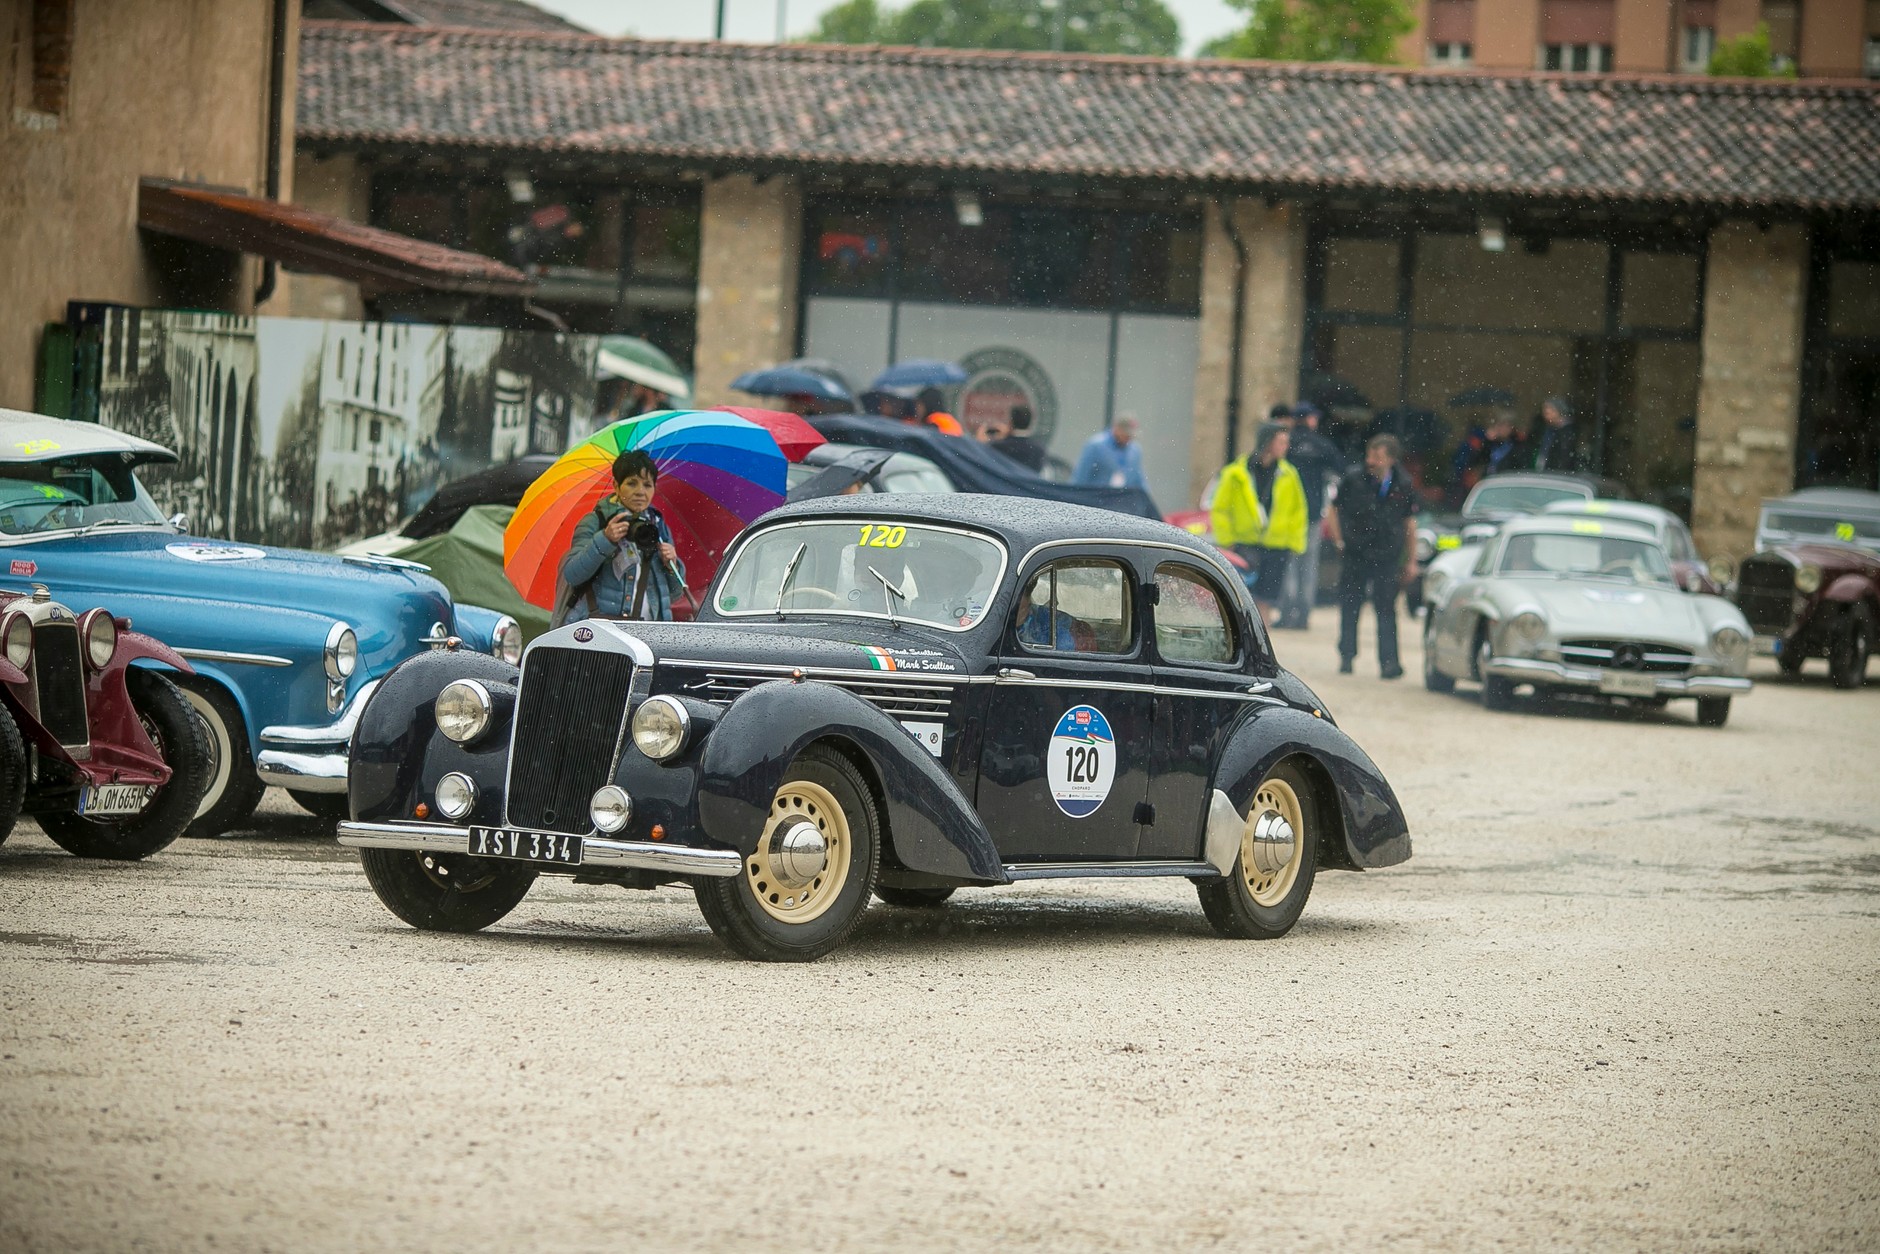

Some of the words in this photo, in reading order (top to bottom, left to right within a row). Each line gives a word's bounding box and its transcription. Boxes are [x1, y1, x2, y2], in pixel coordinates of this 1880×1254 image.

[859, 524, 907, 548] 120
[51, 608, 61, 618] OM
[895, 659, 920, 669] Mark
[921, 659, 955, 671] Scullion
[1066, 746, 1099, 783] 120
[86, 789, 100, 810] LB
[118, 787, 145, 808] 665H
[477, 829, 520, 856] XSV
[529, 833, 571, 861] 334
